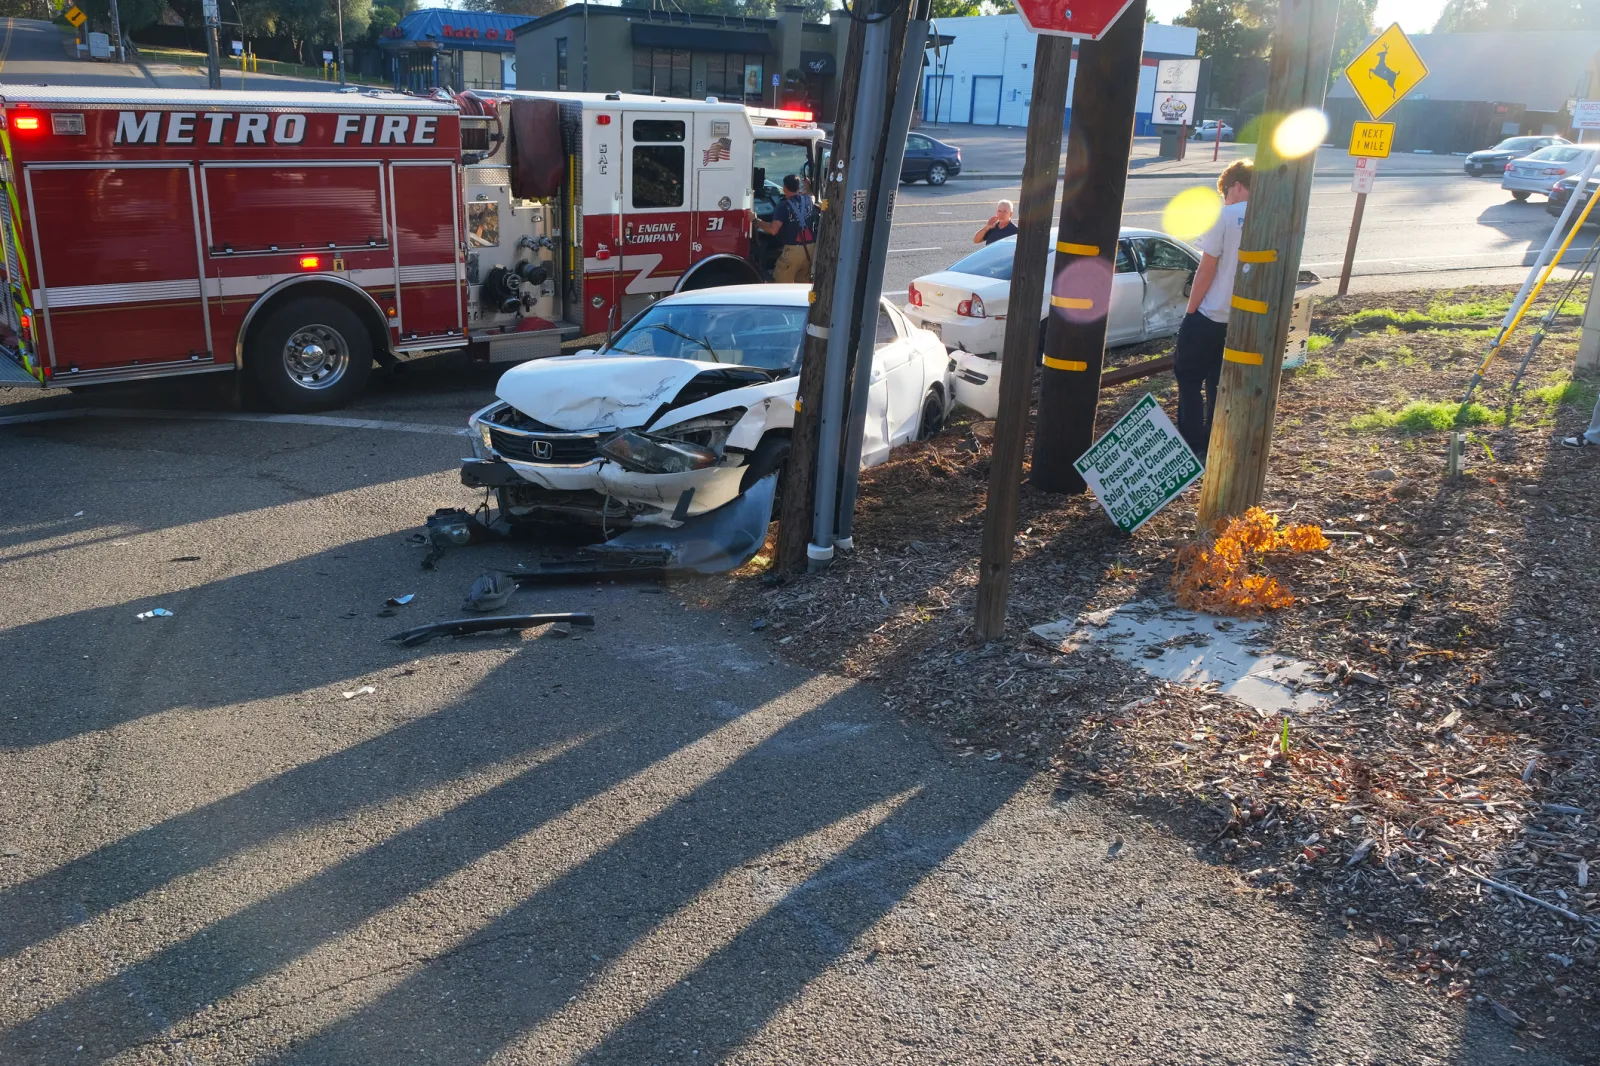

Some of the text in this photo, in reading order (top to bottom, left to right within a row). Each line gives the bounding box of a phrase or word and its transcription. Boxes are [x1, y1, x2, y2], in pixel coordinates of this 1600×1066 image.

[442, 25, 479, 38] Raft
[114, 111, 438, 145] METRO FIRE
[1362, 129, 1384, 139] NEXT
[598, 143, 608, 175] SAC
[1356, 141, 1385, 151] 1 MILE
[1357, 158, 1366, 168] NO
[631, 232, 682, 244] COMPANY
[638, 222, 677, 233] ENGINE
[706, 217, 725, 231] 31
[1080, 401, 1151, 470] Window Washing
[1095, 418, 1155, 474] Gutter Cleaning
[1099, 428, 1168, 490] Pressure Washing
[1103, 484, 1125, 506] Solar
[1122, 465, 1147, 489] Panel
[1144, 436, 1181, 470] Cleaning
[1110, 499, 1131, 520] Roof
[1128, 483, 1151, 504] Moss
[1147, 446, 1191, 486] Treatment
[1121, 461, 1196, 527] 916-993-6799
